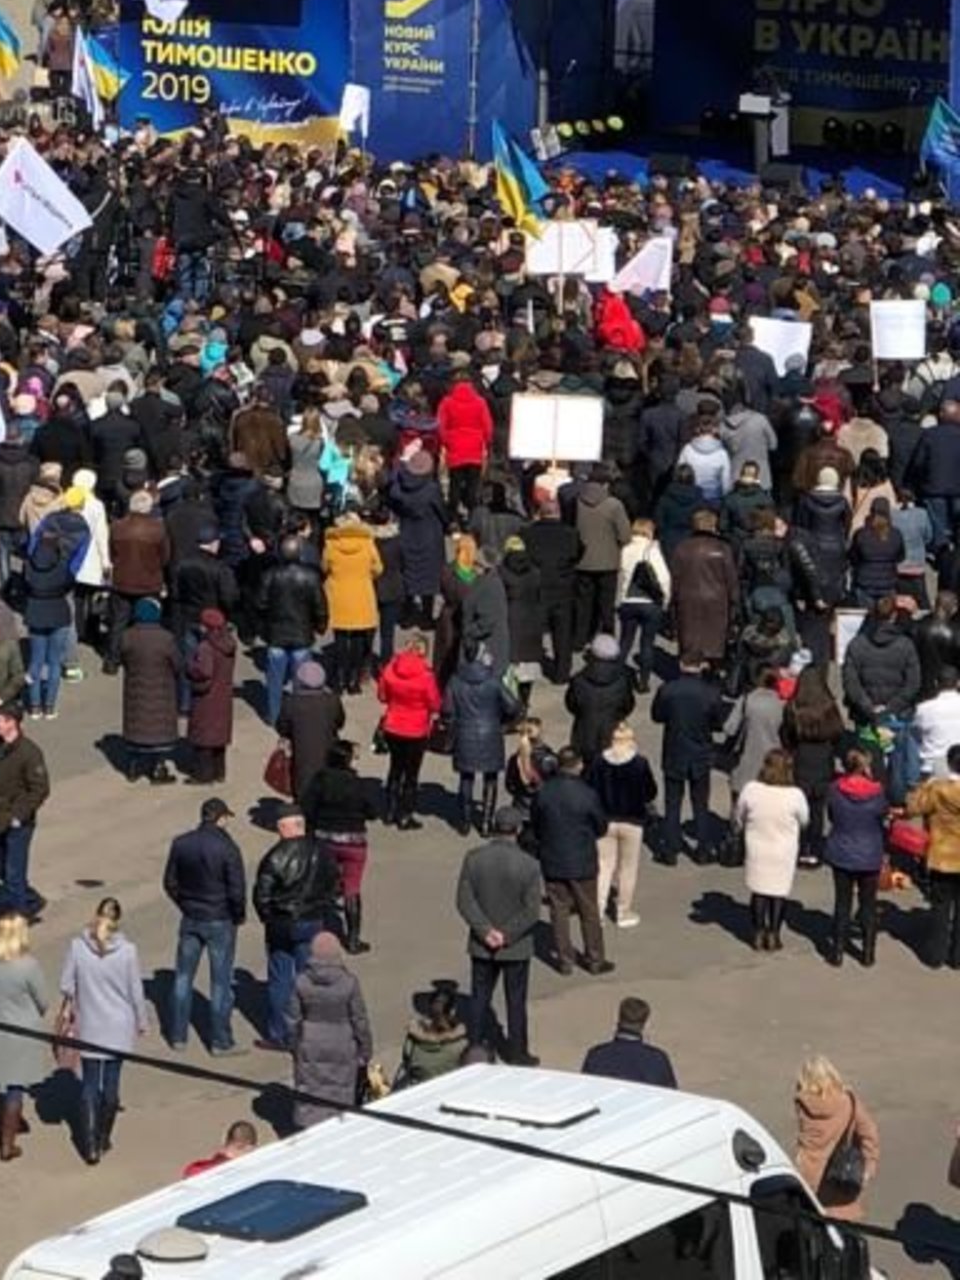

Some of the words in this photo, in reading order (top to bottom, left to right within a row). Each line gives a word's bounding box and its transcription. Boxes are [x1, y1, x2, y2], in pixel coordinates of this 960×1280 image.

[384, 24, 435, 40] НОВИЙ
[754, 19, 779, 51] В
[142, 41, 317, 76] ТИМОШЕНКО
[384, 41, 420, 55] КУРС
[383, 55, 445, 73] УКРАЇНИ
[142, 72, 211, 103] 2019
